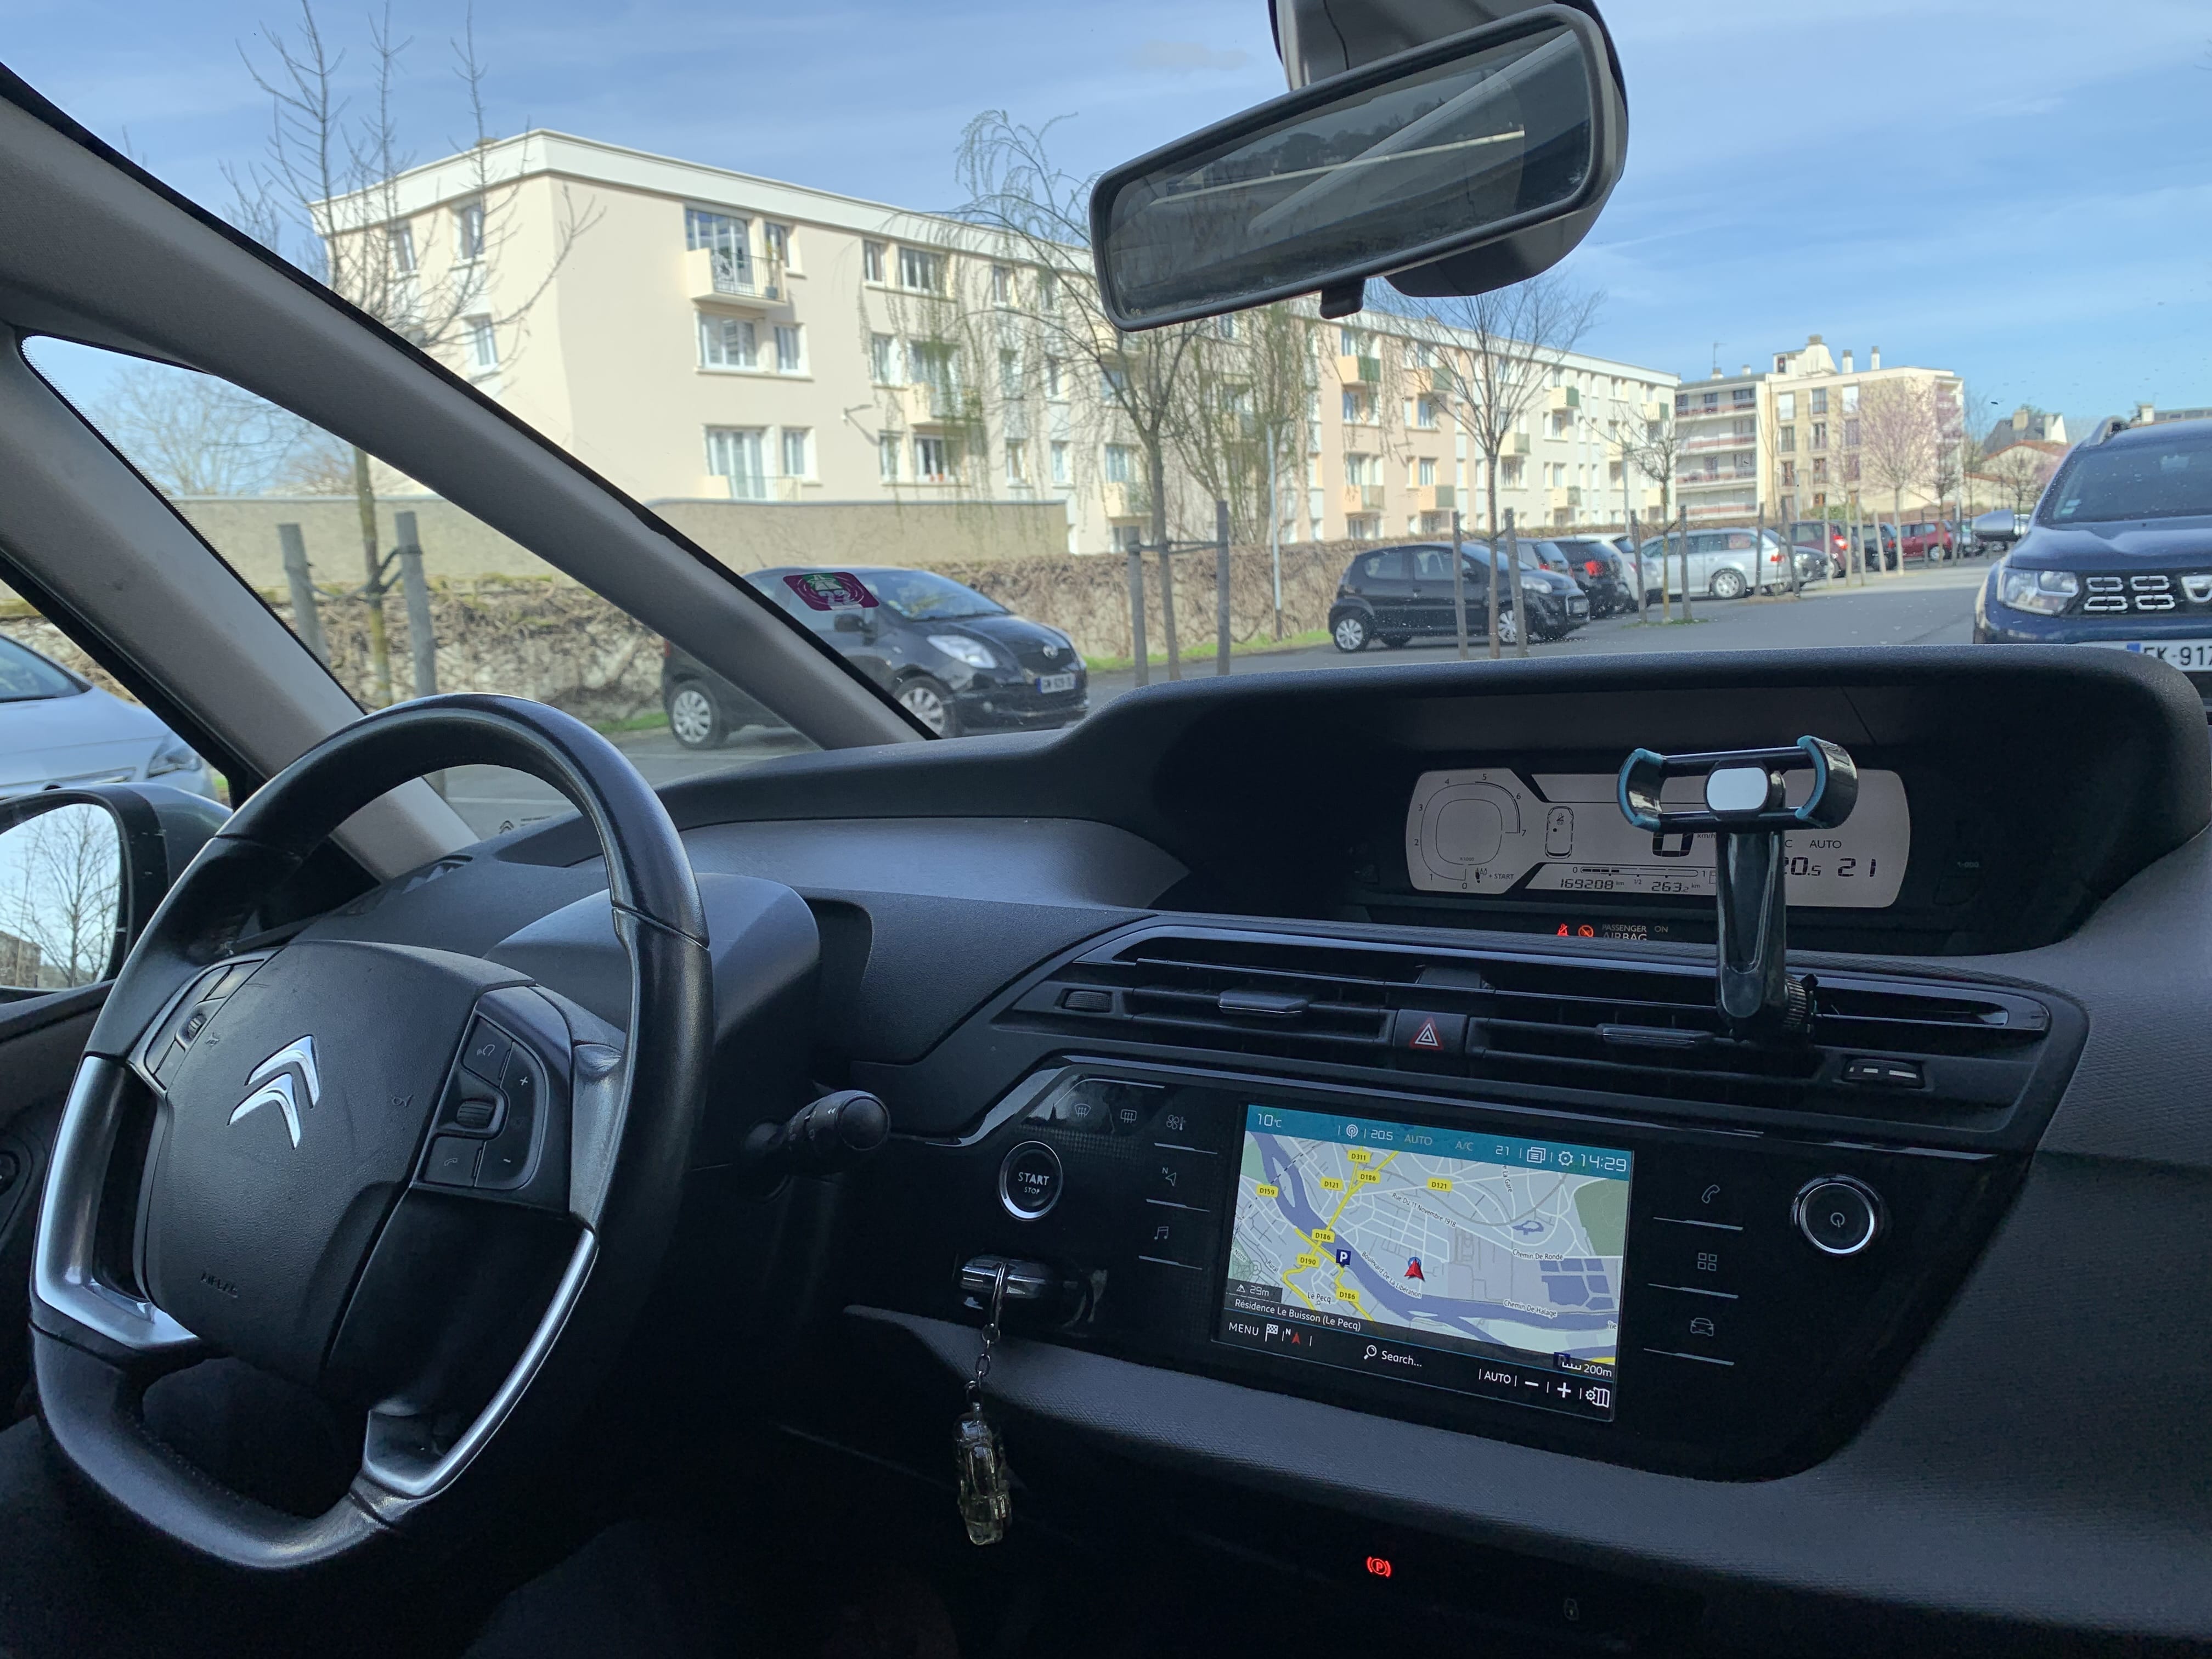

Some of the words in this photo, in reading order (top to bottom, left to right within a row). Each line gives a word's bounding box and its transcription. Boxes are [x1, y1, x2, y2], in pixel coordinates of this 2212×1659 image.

[1809, 840, 1842, 849] AUTO
[1838, 857, 1876, 877] 21
[1560, 878, 1613, 890] 169208
[1651, 881, 1689, 892] 263.2
[1602, 923, 1646, 932] PASSENGER
[1404, 1134, 1432, 1146] AUTO
[1455, 1141, 1474, 1151] A/C
[1496, 1145, 1509, 1155] 21
[1581, 1154, 1627, 1172] 14:29
[1018, 1172, 1049, 1186] START
[1504, 1179, 1513, 1192] Gare
[1392, 1192, 1402, 1202] Rue
[1403, 1198, 1410, 1206] Du
[1418, 1204, 1443, 1221] Novembre
[1444, 1217, 1457, 1227] 1918
[1300, 1257, 1316, 1265] D190
[1512, 1249, 1533, 1260] Chemin
[1267, 1260, 1279, 1273] Rural
[1362, 1251, 1384, 1274] Boulevard
[1383, 1272, 1390, 1280] De
[1389, 1278, 1396, 1286] La
[1396, 1283, 1421, 1297] Libération
[1250, 1285, 1269, 1296] 29m
[1316, 1293, 1331, 1304] Pecq
[1235, 1299, 1275, 1313] Résidence
[1277, 1306, 1287, 1316] Le
[1289, 1309, 1321, 1323] Buisson
[1322, 1315, 1335, 1326] (Le
[1338, 1318, 1361, 1332] Pecq)
[1504, 1300, 1525, 1310] Chemin
[1536, 1306, 1557, 1318] Halage
[1228, 1322, 1260, 1335] MENU
[1381, 1350, 1422, 1367] Search...
[1484, 1370, 1511, 1384] AUTO
[1583, 1364, 1612, 1377] 200m
